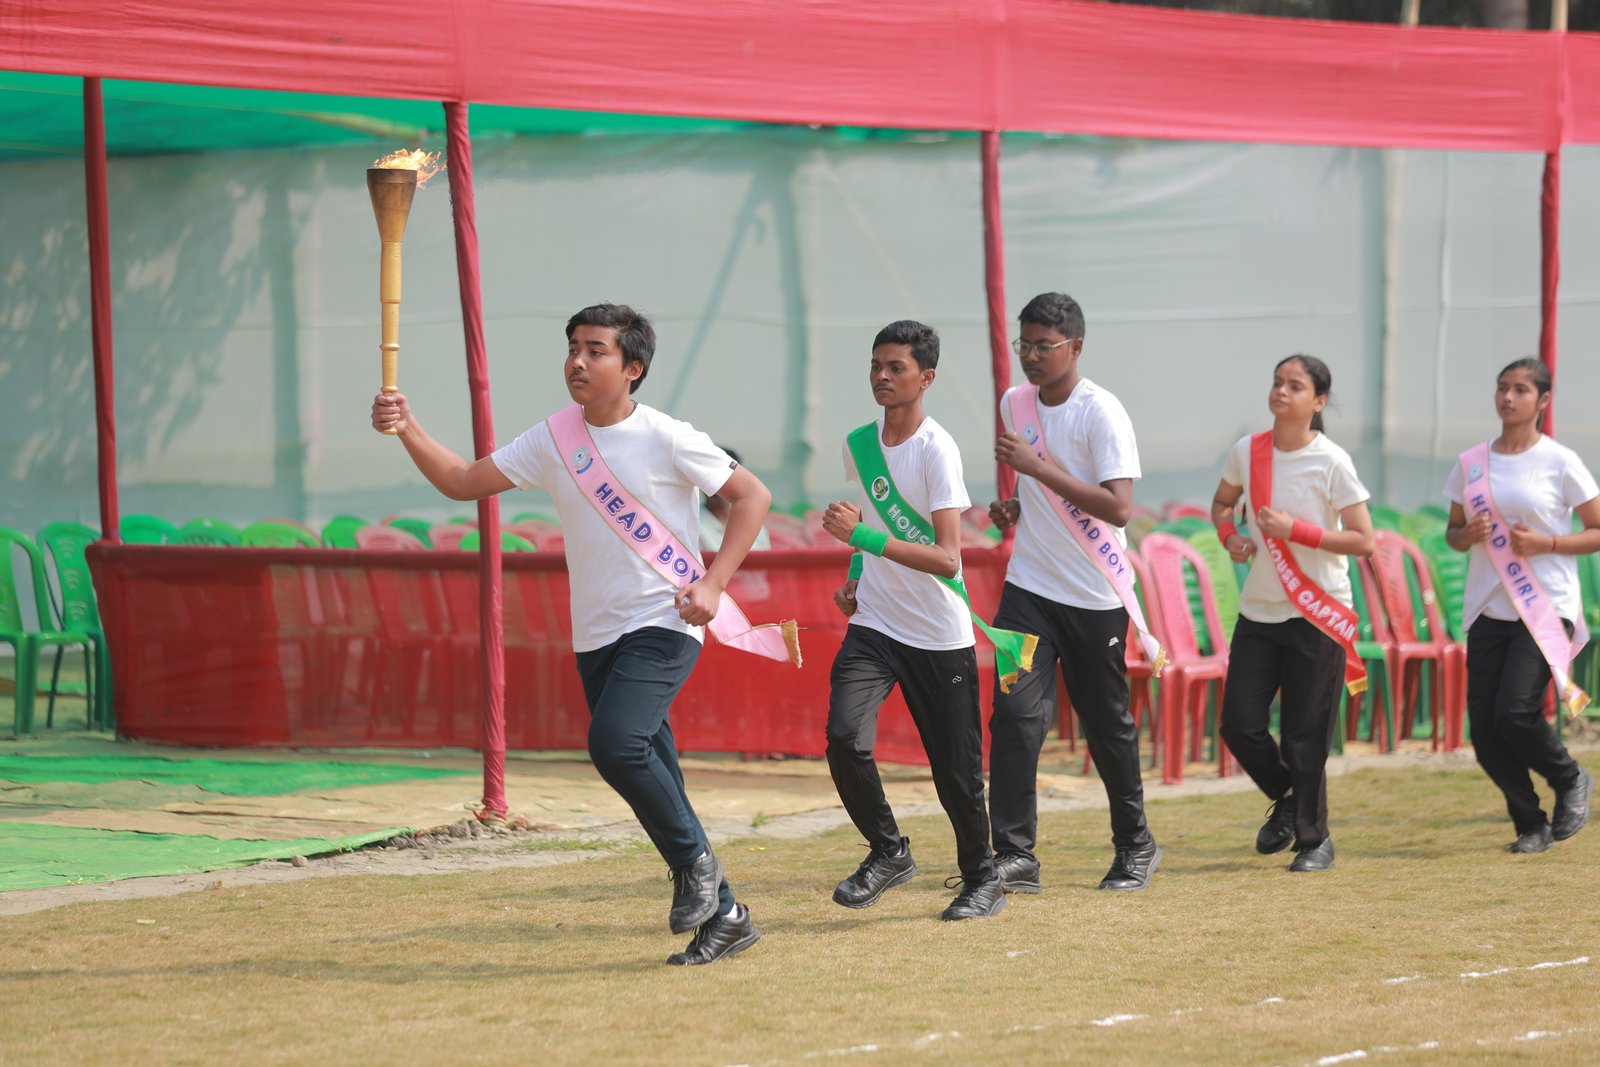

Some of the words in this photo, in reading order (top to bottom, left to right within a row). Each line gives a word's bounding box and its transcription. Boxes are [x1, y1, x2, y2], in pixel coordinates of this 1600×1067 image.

[594, 482, 652, 542] HEAD
[657, 544, 700, 584] BOY
[887, 503, 935, 546] HOUS
[1098, 542, 1125, 576] BOY
[1506, 561, 1537, 607] GIRL
[1297, 590, 1355, 640] CAPTAI
